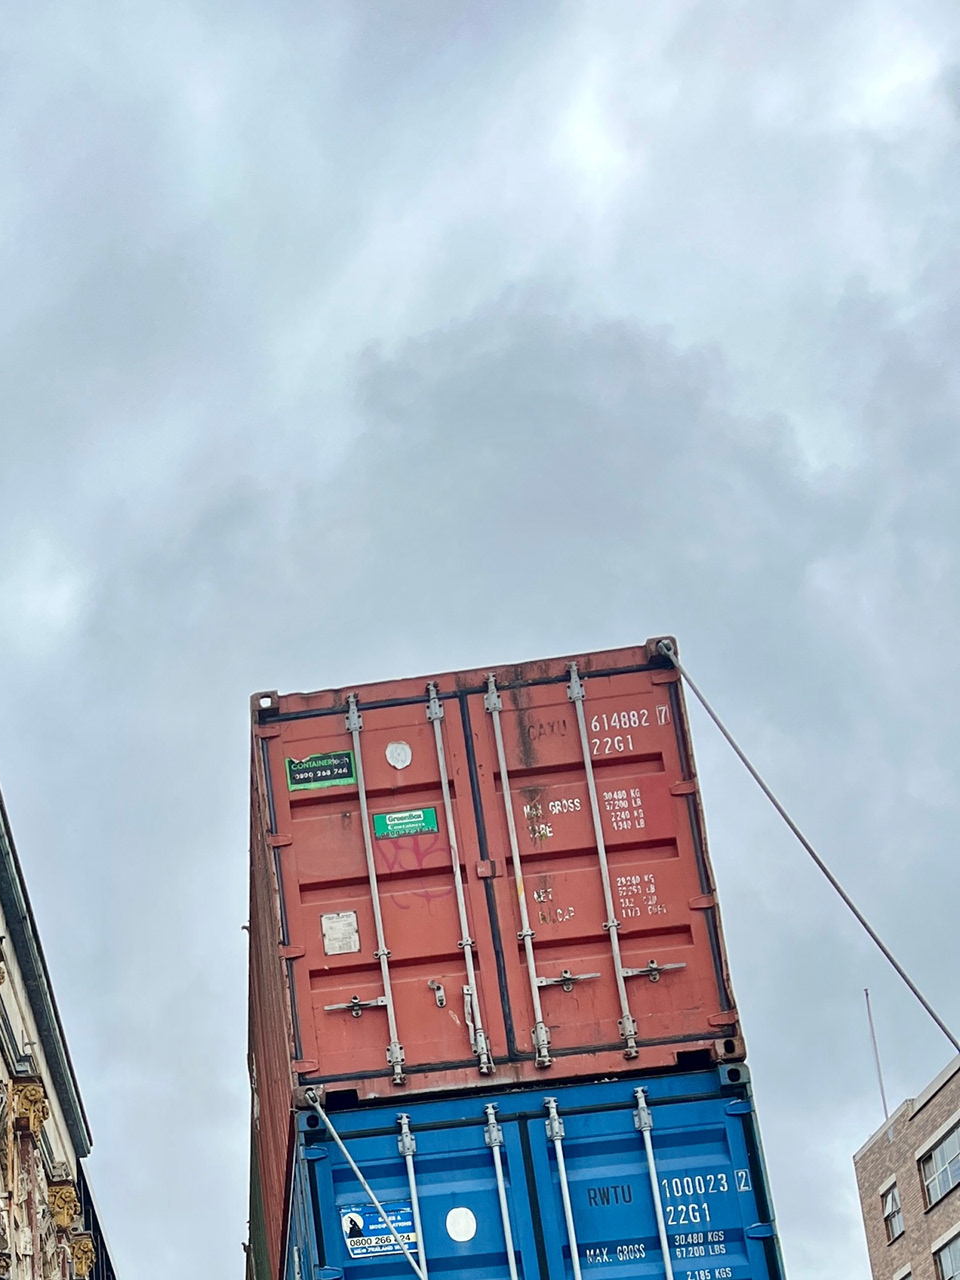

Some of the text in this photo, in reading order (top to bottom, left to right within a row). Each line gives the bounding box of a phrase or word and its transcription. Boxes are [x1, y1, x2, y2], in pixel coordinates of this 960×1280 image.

[528, 706, 668, 740] CAXU 614882 7
[591, 735, 634, 755] 22G1
[294, 772, 313, 780] 0800
[603, 788, 640, 800] 30480 KG
[549, 798, 581, 814] GROSS
[388, 813, 422, 823] GreenBox
[635, 819, 645, 828] LB
[587, 1170, 751, 1207] RWTU 100023 2
[666, 1202, 711, 1225] 22G1
[349, 1234, 411, 1247] 0800 266 24
[674, 1231, 725, 1246] 30.480 KGS
[586, 1243, 726, 1264] MAX. GROSS 67.200 LBS
[715, 1267, 732, 1279] KGS
